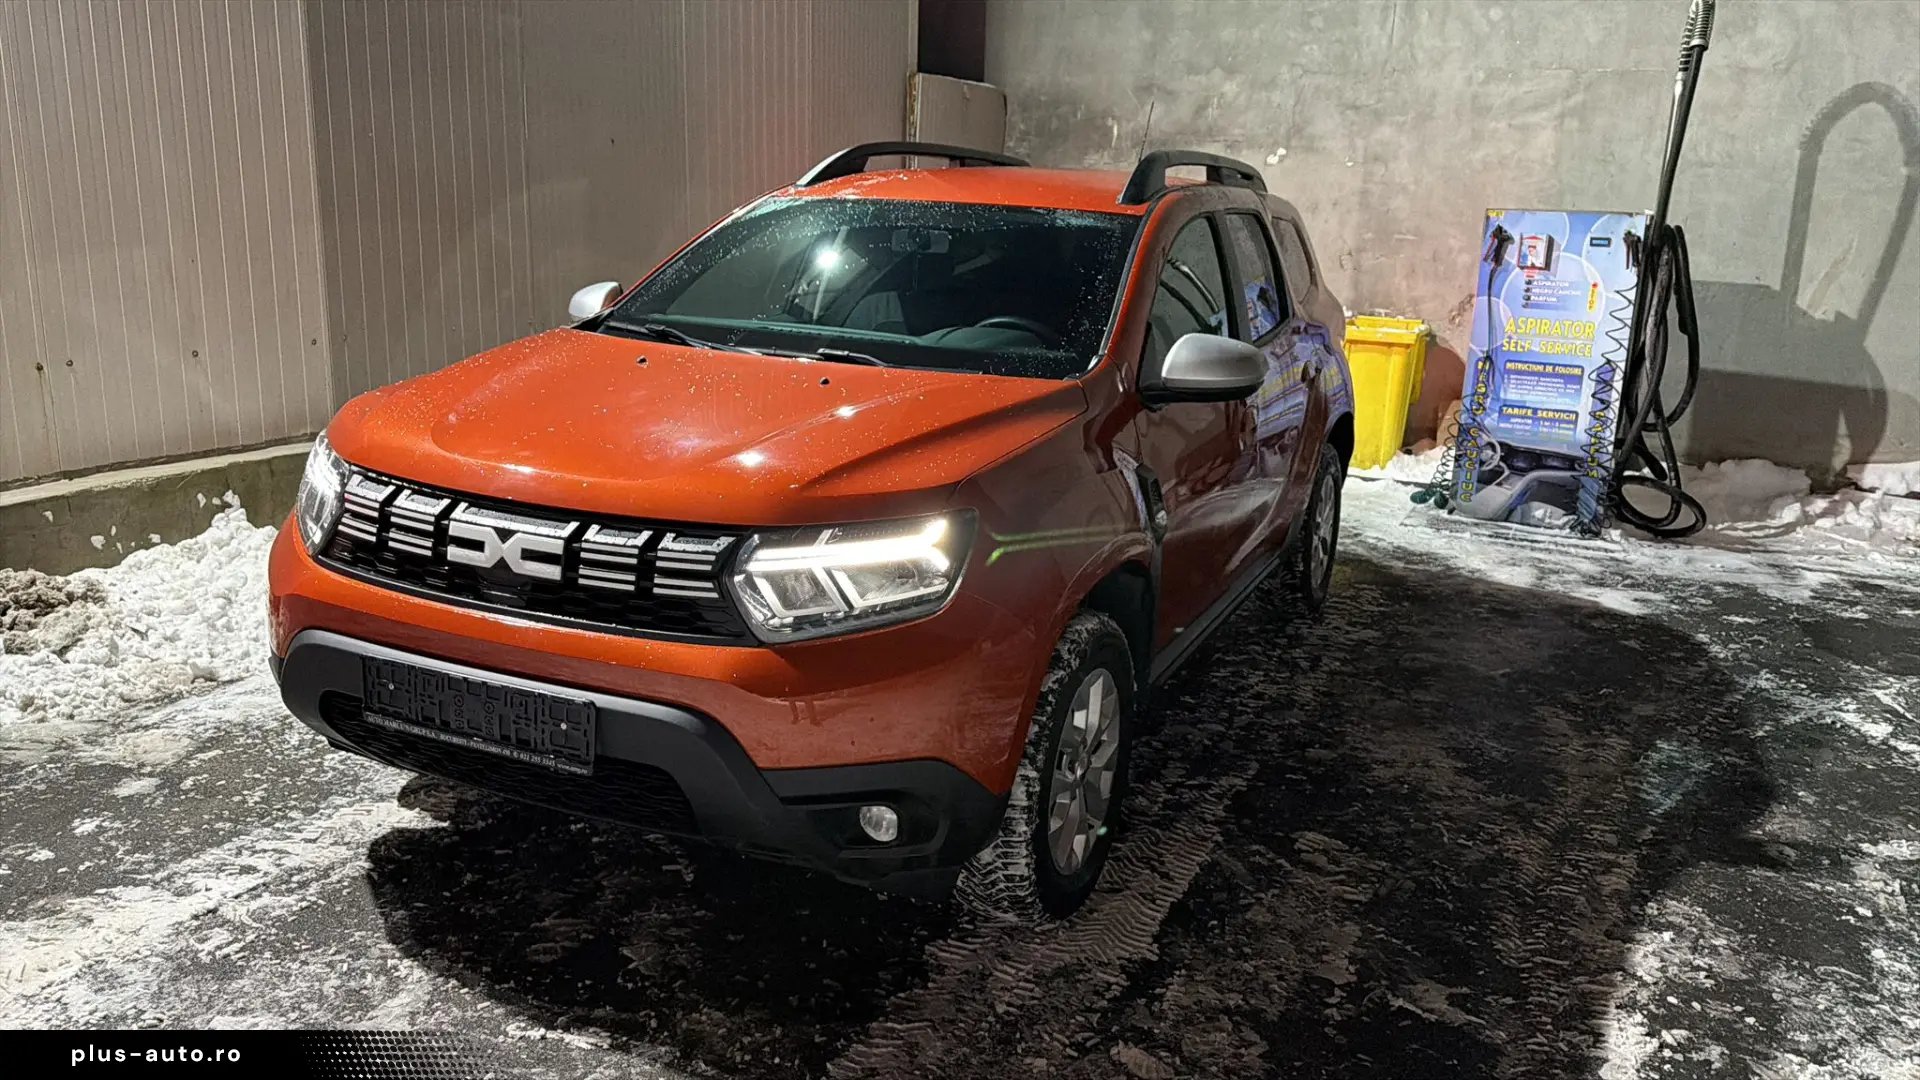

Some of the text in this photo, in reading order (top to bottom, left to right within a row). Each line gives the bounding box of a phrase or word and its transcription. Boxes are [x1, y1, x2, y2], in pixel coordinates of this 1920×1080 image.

[1504, 316, 1597, 340] ASPIRATOR
[1502, 337, 1594, 358] SELF SERVICE
[1546, 365, 1554, 373] DE
[1554, 366, 1583, 375] FOLOSIRE
[1502, 406, 1577, 421] TARIFE SERVICII
